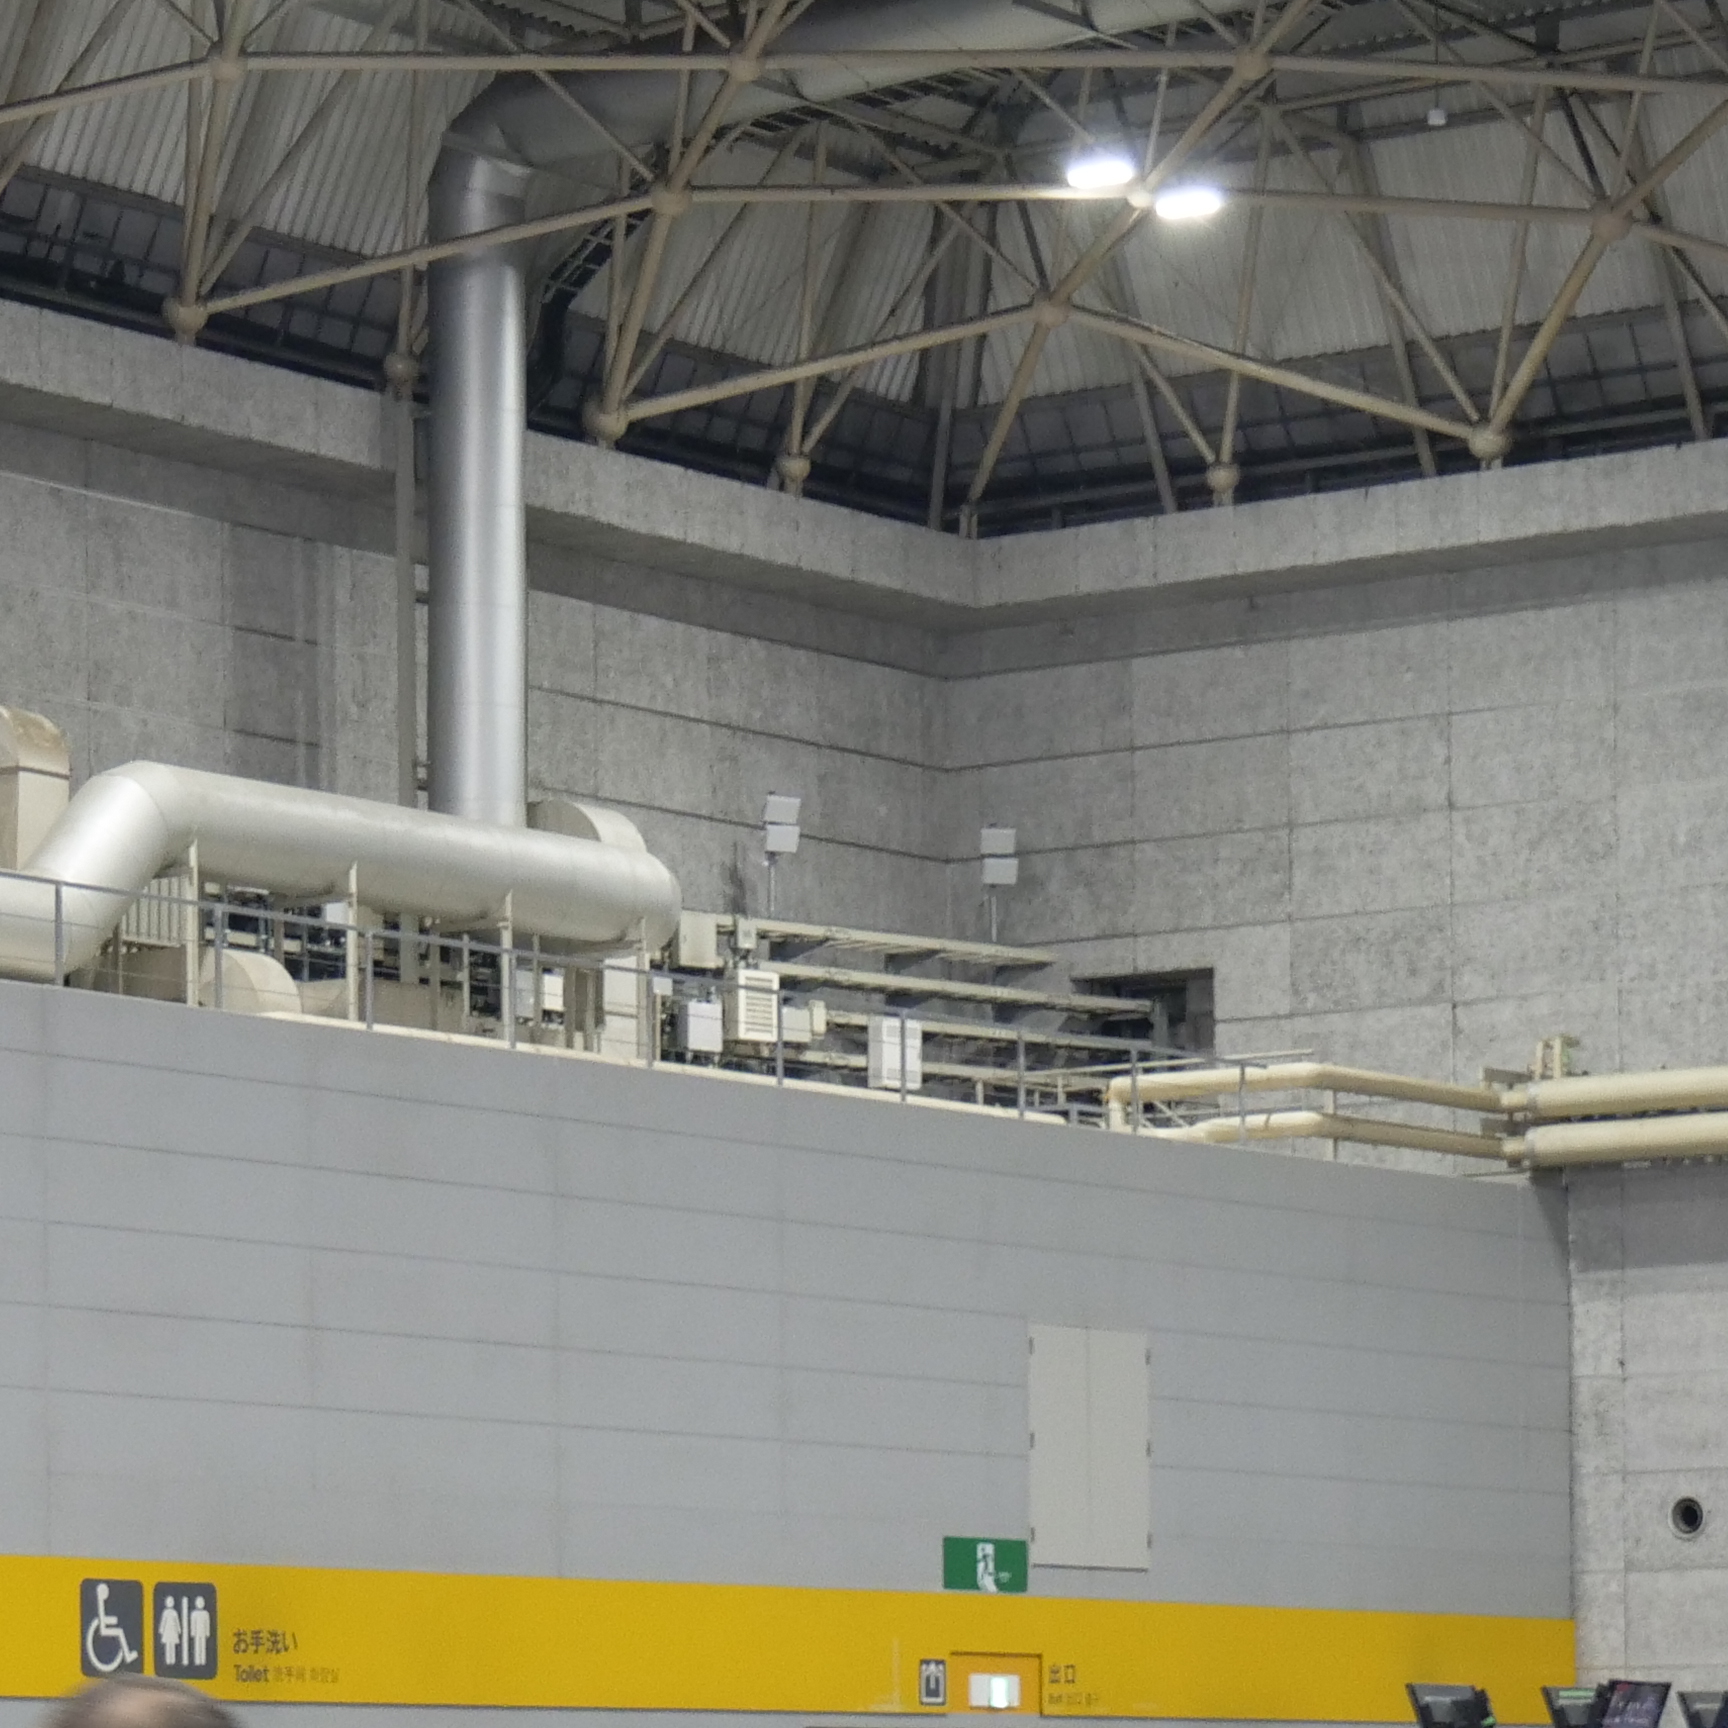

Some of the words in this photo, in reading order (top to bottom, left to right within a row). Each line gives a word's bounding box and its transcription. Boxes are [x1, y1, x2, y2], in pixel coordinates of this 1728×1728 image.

[233, 1628, 298, 1655] お手洗い
[233, 1664, 270, 1683] Toilet
